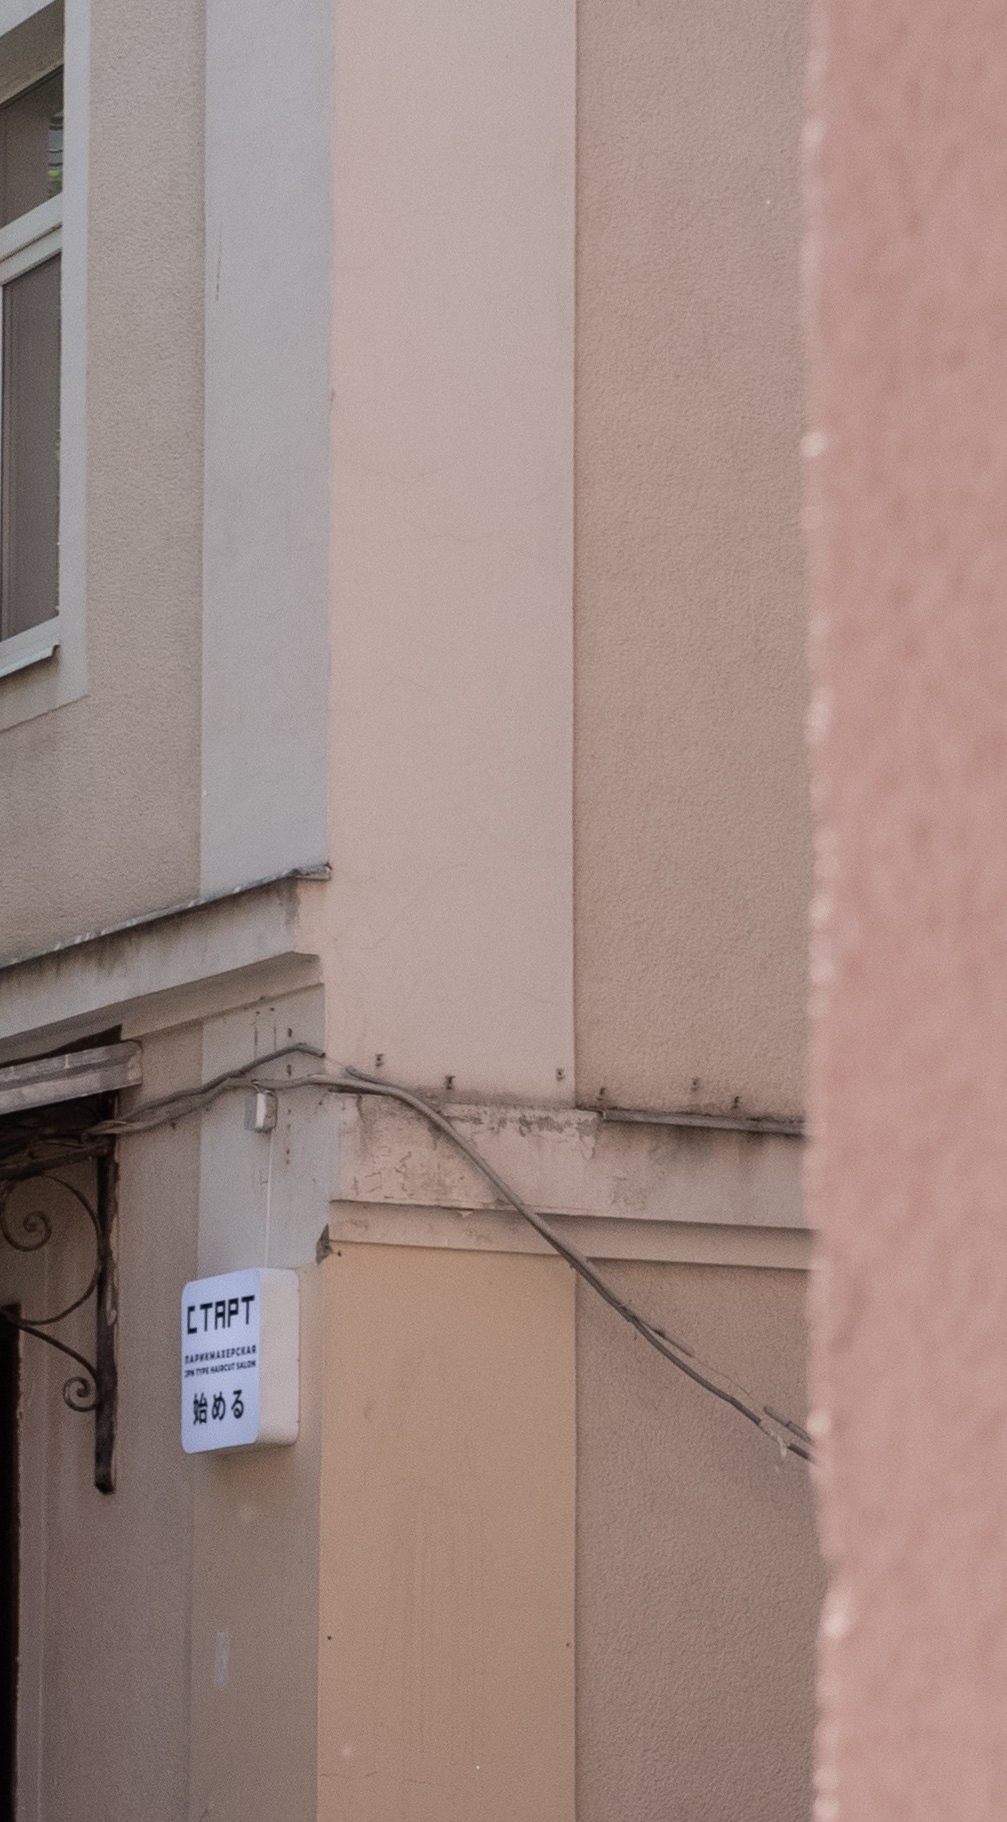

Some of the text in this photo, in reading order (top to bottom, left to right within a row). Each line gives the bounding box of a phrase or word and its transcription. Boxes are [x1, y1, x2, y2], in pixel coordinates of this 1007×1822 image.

[187, 1295, 255, 1334] СТАРТ
[184, 1345, 256, 1365] ПАРИКМАХЕРСКАЯ
[196, 1367, 209, 1377] TYPE
[210, 1362, 235, 1374] HAIRCUT
[236, 1360, 256, 1371] SALON
[193, 1389, 244, 1425] 始める
